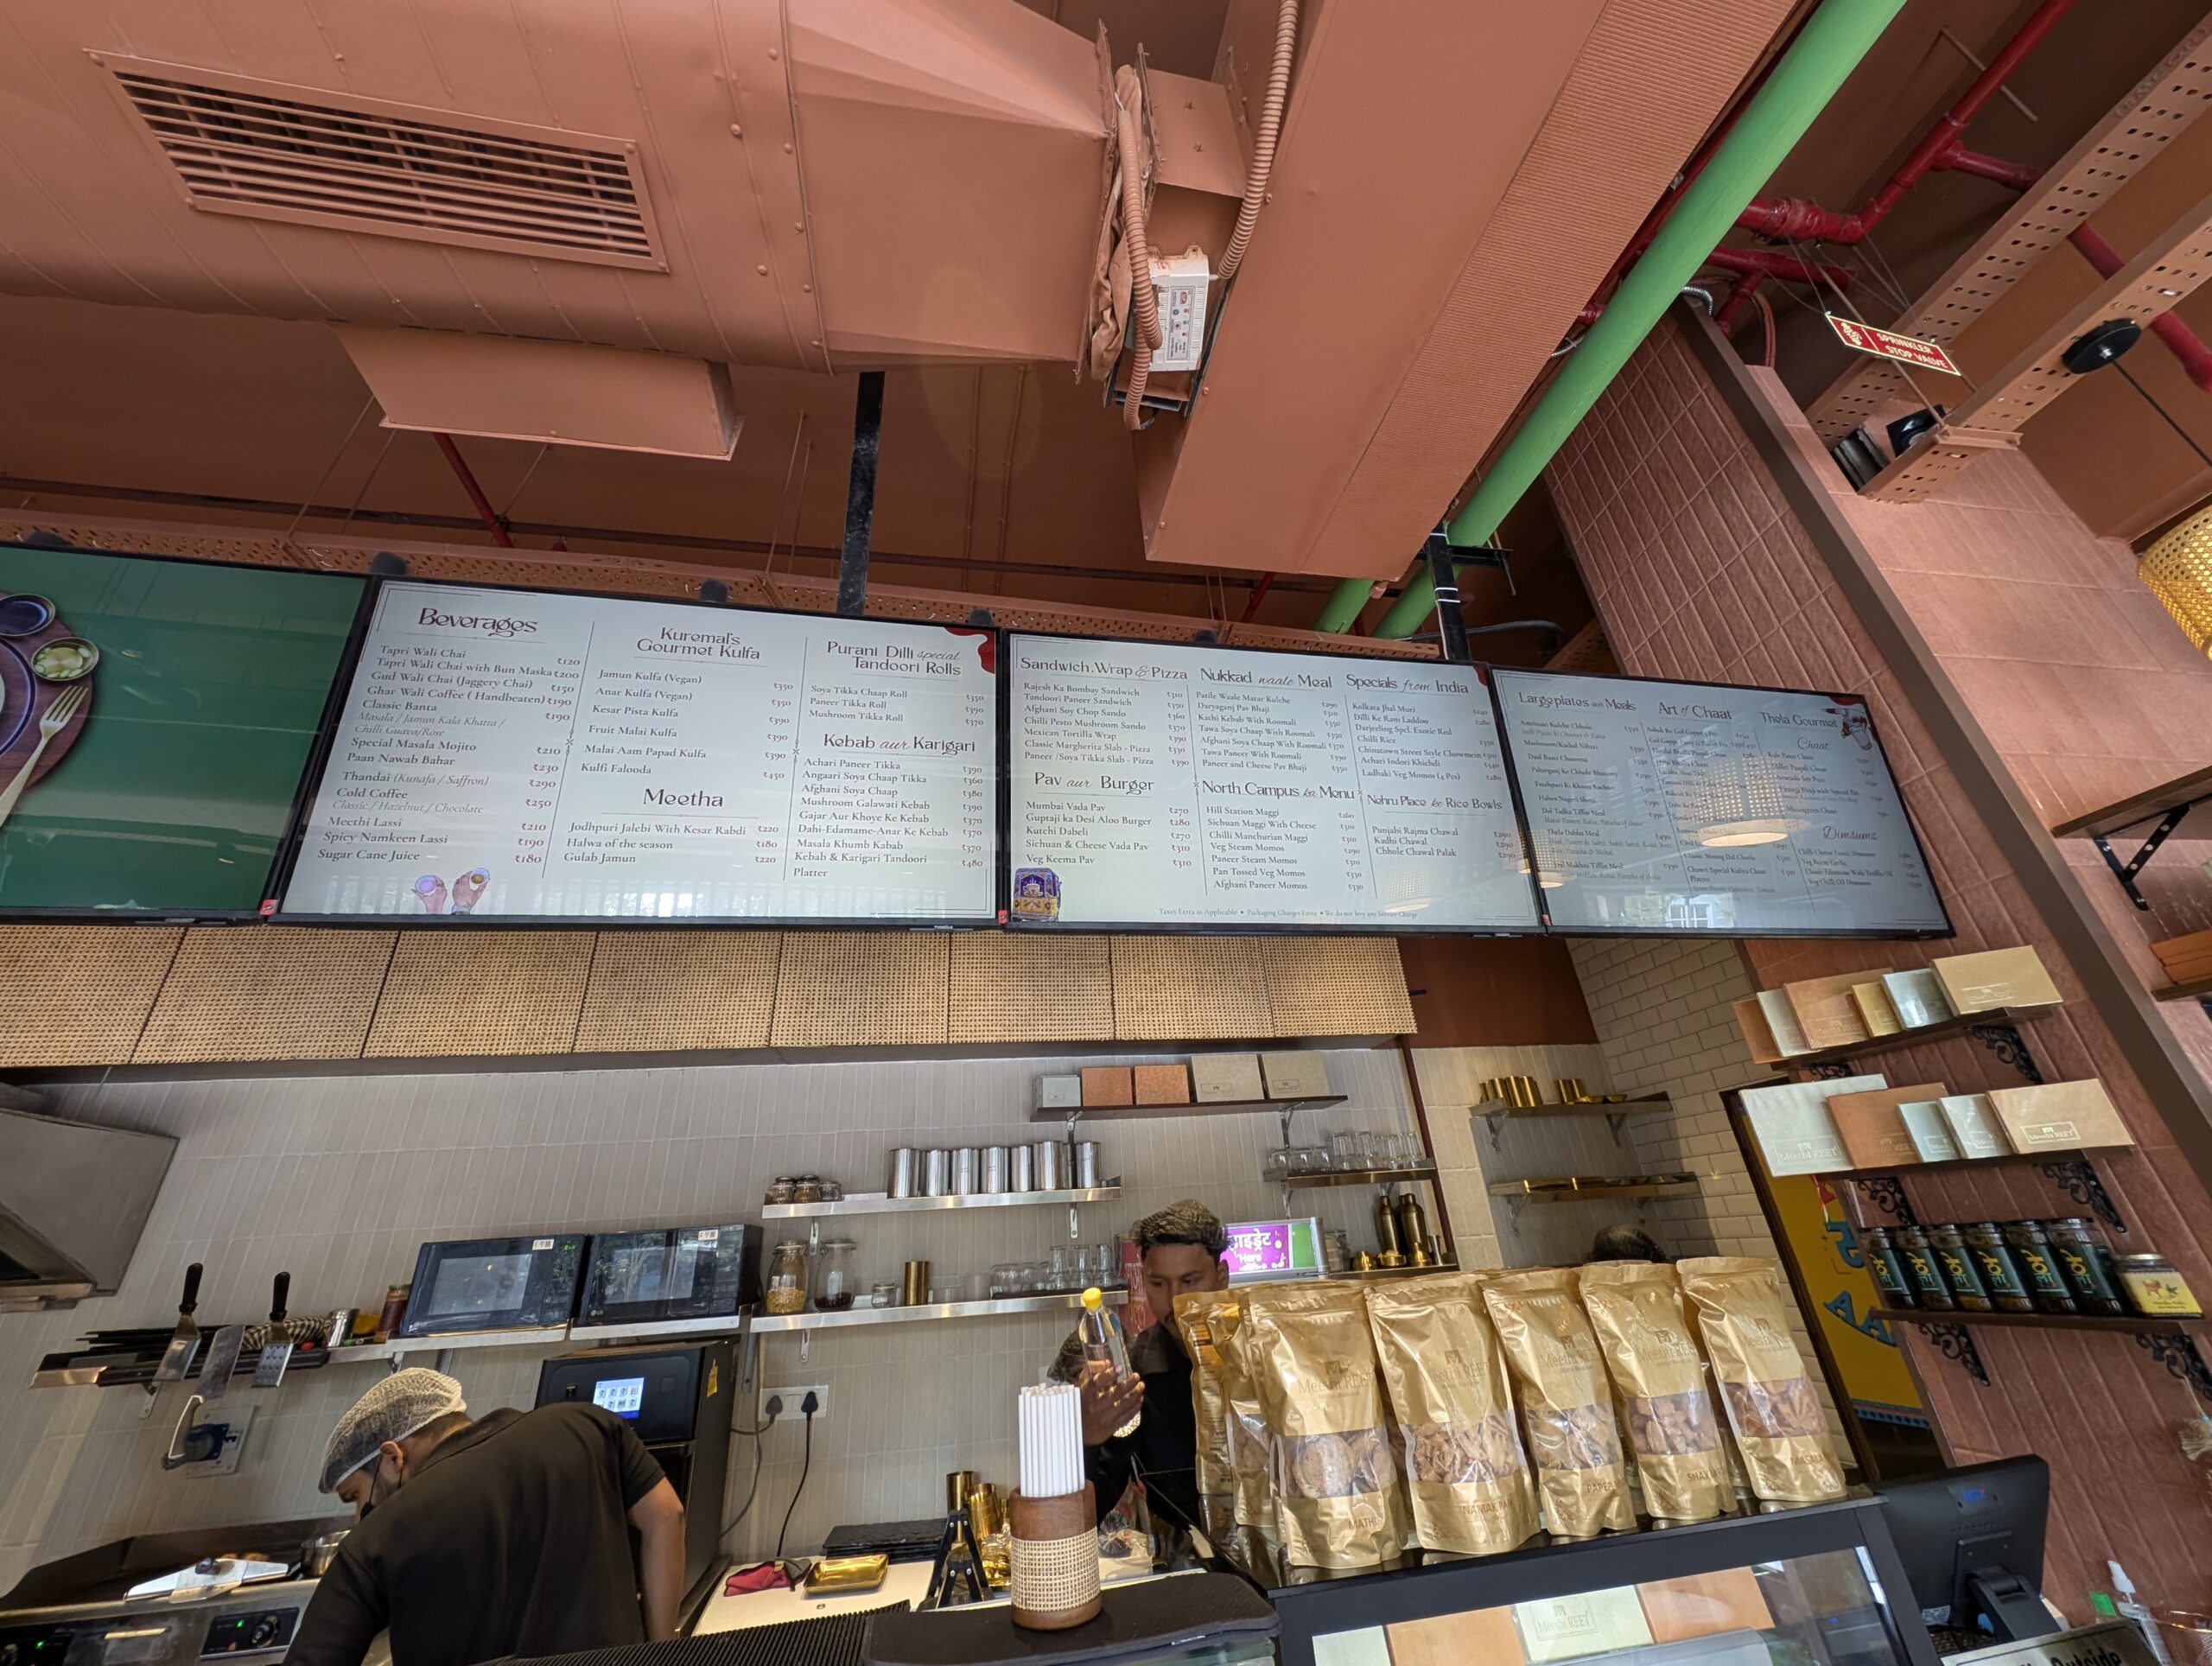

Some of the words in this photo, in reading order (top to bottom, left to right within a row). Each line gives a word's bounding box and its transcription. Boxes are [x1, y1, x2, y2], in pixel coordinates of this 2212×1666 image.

[1876, 333, 1935, 354] SPRINKLER
[1885, 345, 1912, 358] STOP
[1913, 353, 1948, 369] VALVE
[417, 607, 538, 639] Beverages
[660, 626, 741, 645] Kuremal's
[379, 645, 410, 657] Tapri
[413, 646, 438, 657] Wali
[439, 648, 467, 658] Chai
[636, 638, 713, 656] Gourmet
[719, 644, 760, 660] Kulfa
[827, 640, 878, 657] Purani
[885, 645, 914, 659] Dilli
[916, 650, 960, 661] special
[851, 655, 919, 673] Tandoori
[925, 660, 961, 676] Rolls
[1134, 664, 1150, 678] &
[1151, 665, 1187, 680] Pizza
[371, 671, 397, 681] Gud
[399, 672, 424, 683] Wali
[426, 673, 454, 684] Chai
[455, 675, 500, 689] (Jaggery
[502, 677, 533, 690] Chai)
[596, 669, 632, 679] Jamun
[634, 671, 662, 681] Kulfa
[664, 672, 702, 685] (Vegan)
[1199, 667, 1252, 684] Nukkad
[1297, 673, 1332, 688] Meal
[1345, 673, 1398, 690] Specials
[1402, 678, 1430, 693] from
[1434, 679, 1469, 694] India
[361, 698, 402, 710] Classic
[404, 701, 437, 711] Banta
[592, 704, 622, 714] Kesar
[623, 706, 649, 715] Pista
[651, 707, 678, 717] Kulfa
[810, 696, 840, 706] Paneer
[840, 698, 867, 708] Tikka
[868, 700, 887, 709] Roll
[1023, 703, 1058, 715] Afghani
[1058, 706, 1075, 717] Soy
[1076, 706, 1099, 718] Chop
[1100, 708, 1127, 717] Sando
[1658, 702, 1679, 715] Art
[1691, 704, 1732, 720] Chaat
[1759, 711, 1790, 725] Thela
[1791, 714, 1839, 728] Gourmet
[350, 736, 393, 749] Special
[395, 738, 435, 749] Masala
[437, 741, 477, 754] Mojito
[536, 746, 561, 755] ₹210
[823, 733, 875, 749] Kebab
[879, 740, 910, 750] aur
[912, 735, 975, 756] Karigari
[1796, 736, 1829, 751] Chaat
[346, 752, 375, 762] Paan
[377, 753, 419, 764] Nawab
[421, 754, 455, 766] Bahar
[581, 762, 608, 773] Kulfi
[610, 763, 652, 774] Falooda
[801, 782, 841, 796] Afghani
[842, 785, 865, 797] Soya
[867, 785, 899, 798] Chaap
[1034, 771, 1062, 785] Pav
[1065, 779, 1090, 788] aur
[1100, 774, 1154, 795] Burger
[1201, 779, 1242, 795] North
[1243, 781, 1300, 799] Campus
[1302, 787, 1318, 798] ka
[1319, 785, 1355, 799] Menu
[335, 786, 367, 798] Cold
[368, 787, 409, 799] Coffee
[524, 798, 552, 810] ₹250
[643, 788, 723, 807] Meetha
[800, 796, 854, 807] Mushroom
[855, 798, 898, 809] Galawati
[900, 799, 930, 810] Kebab
[1026, 800, 1064, 811] Mumbai
[1065, 801, 1088, 811] Vada
[1090, 802, 1106, 811] Pav
[1366, 793, 1399, 806] Nehru
[1399, 795, 1427, 807] Place
[1445, 797, 1469, 809] Rice
[1471, 798, 1503, 810] Bowls
[327, 815, 371, 827] Meethi
[372, 817, 403, 828] Lassi
[520, 822, 547, 831] ₹210
[1026, 824, 1057, 836] Kutchi
[1058, 826, 1089, 836] Dabeli
[322, 830, 358, 844] Spicy
[359, 830, 416, 843] Namkeen
[419, 833, 448, 844] Lassi
[566, 836, 602, 848] Halwa
[604, 837, 620, 848] of
[619, 837, 637, 849] the
[796, 837, 830, 849] Masala
[833, 838, 870, 849] Khumb
[872, 839, 904, 850] Kabab
[1209, 841, 1227, 854] Veg
[1227, 842, 1253, 851] Steam
[1254, 843, 1285, 852] Momos
[317, 849, 353, 862] Sugar
[355, 849, 388, 860] Cane
[387, 849, 421, 862] Juice
[514, 854, 542, 863] ₹180
[563, 851, 598, 862] Gulab
[598, 852, 636, 865] Jamun
